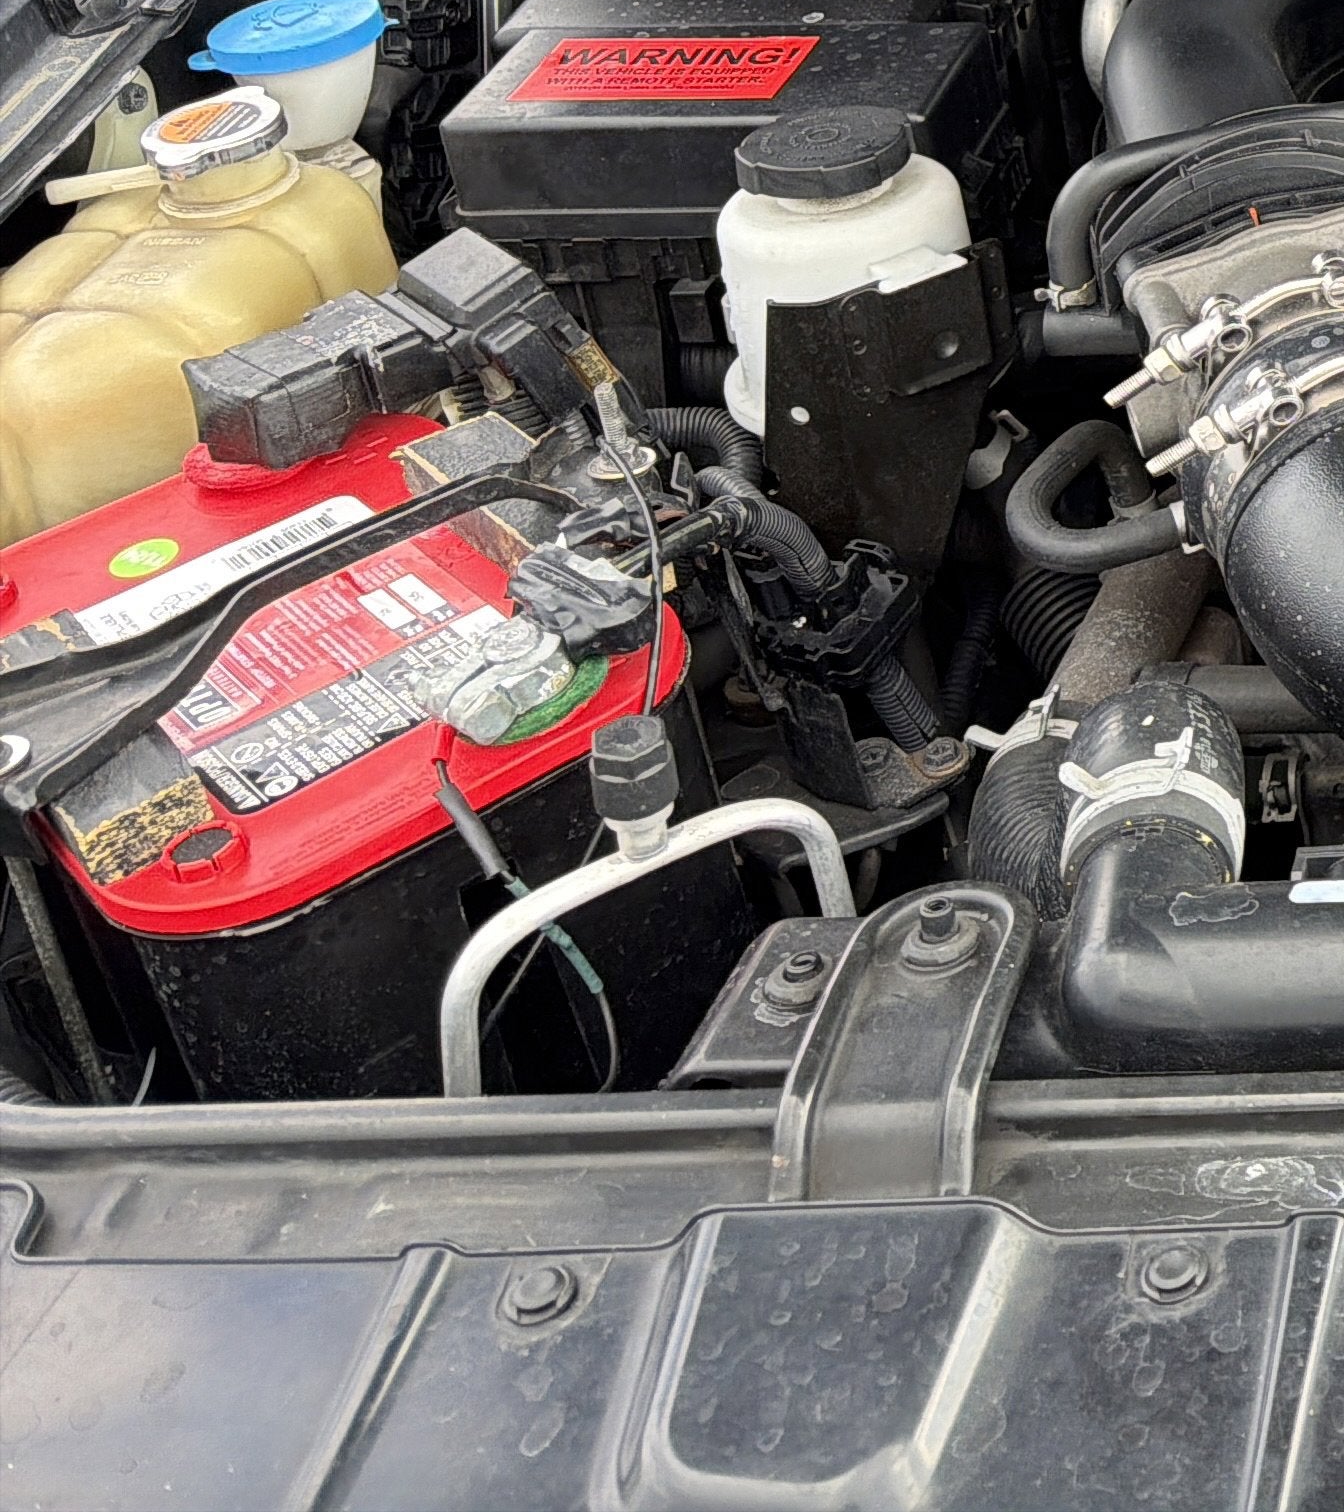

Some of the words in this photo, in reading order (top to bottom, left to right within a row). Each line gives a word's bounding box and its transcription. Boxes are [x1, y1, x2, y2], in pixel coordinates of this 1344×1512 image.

[558, 47, 802, 66] WARNING!
[687, 67, 776, 75] EQUIPPED
[546, 77, 588, 85] WITH
[606, 76, 677, 86] REMOTE
